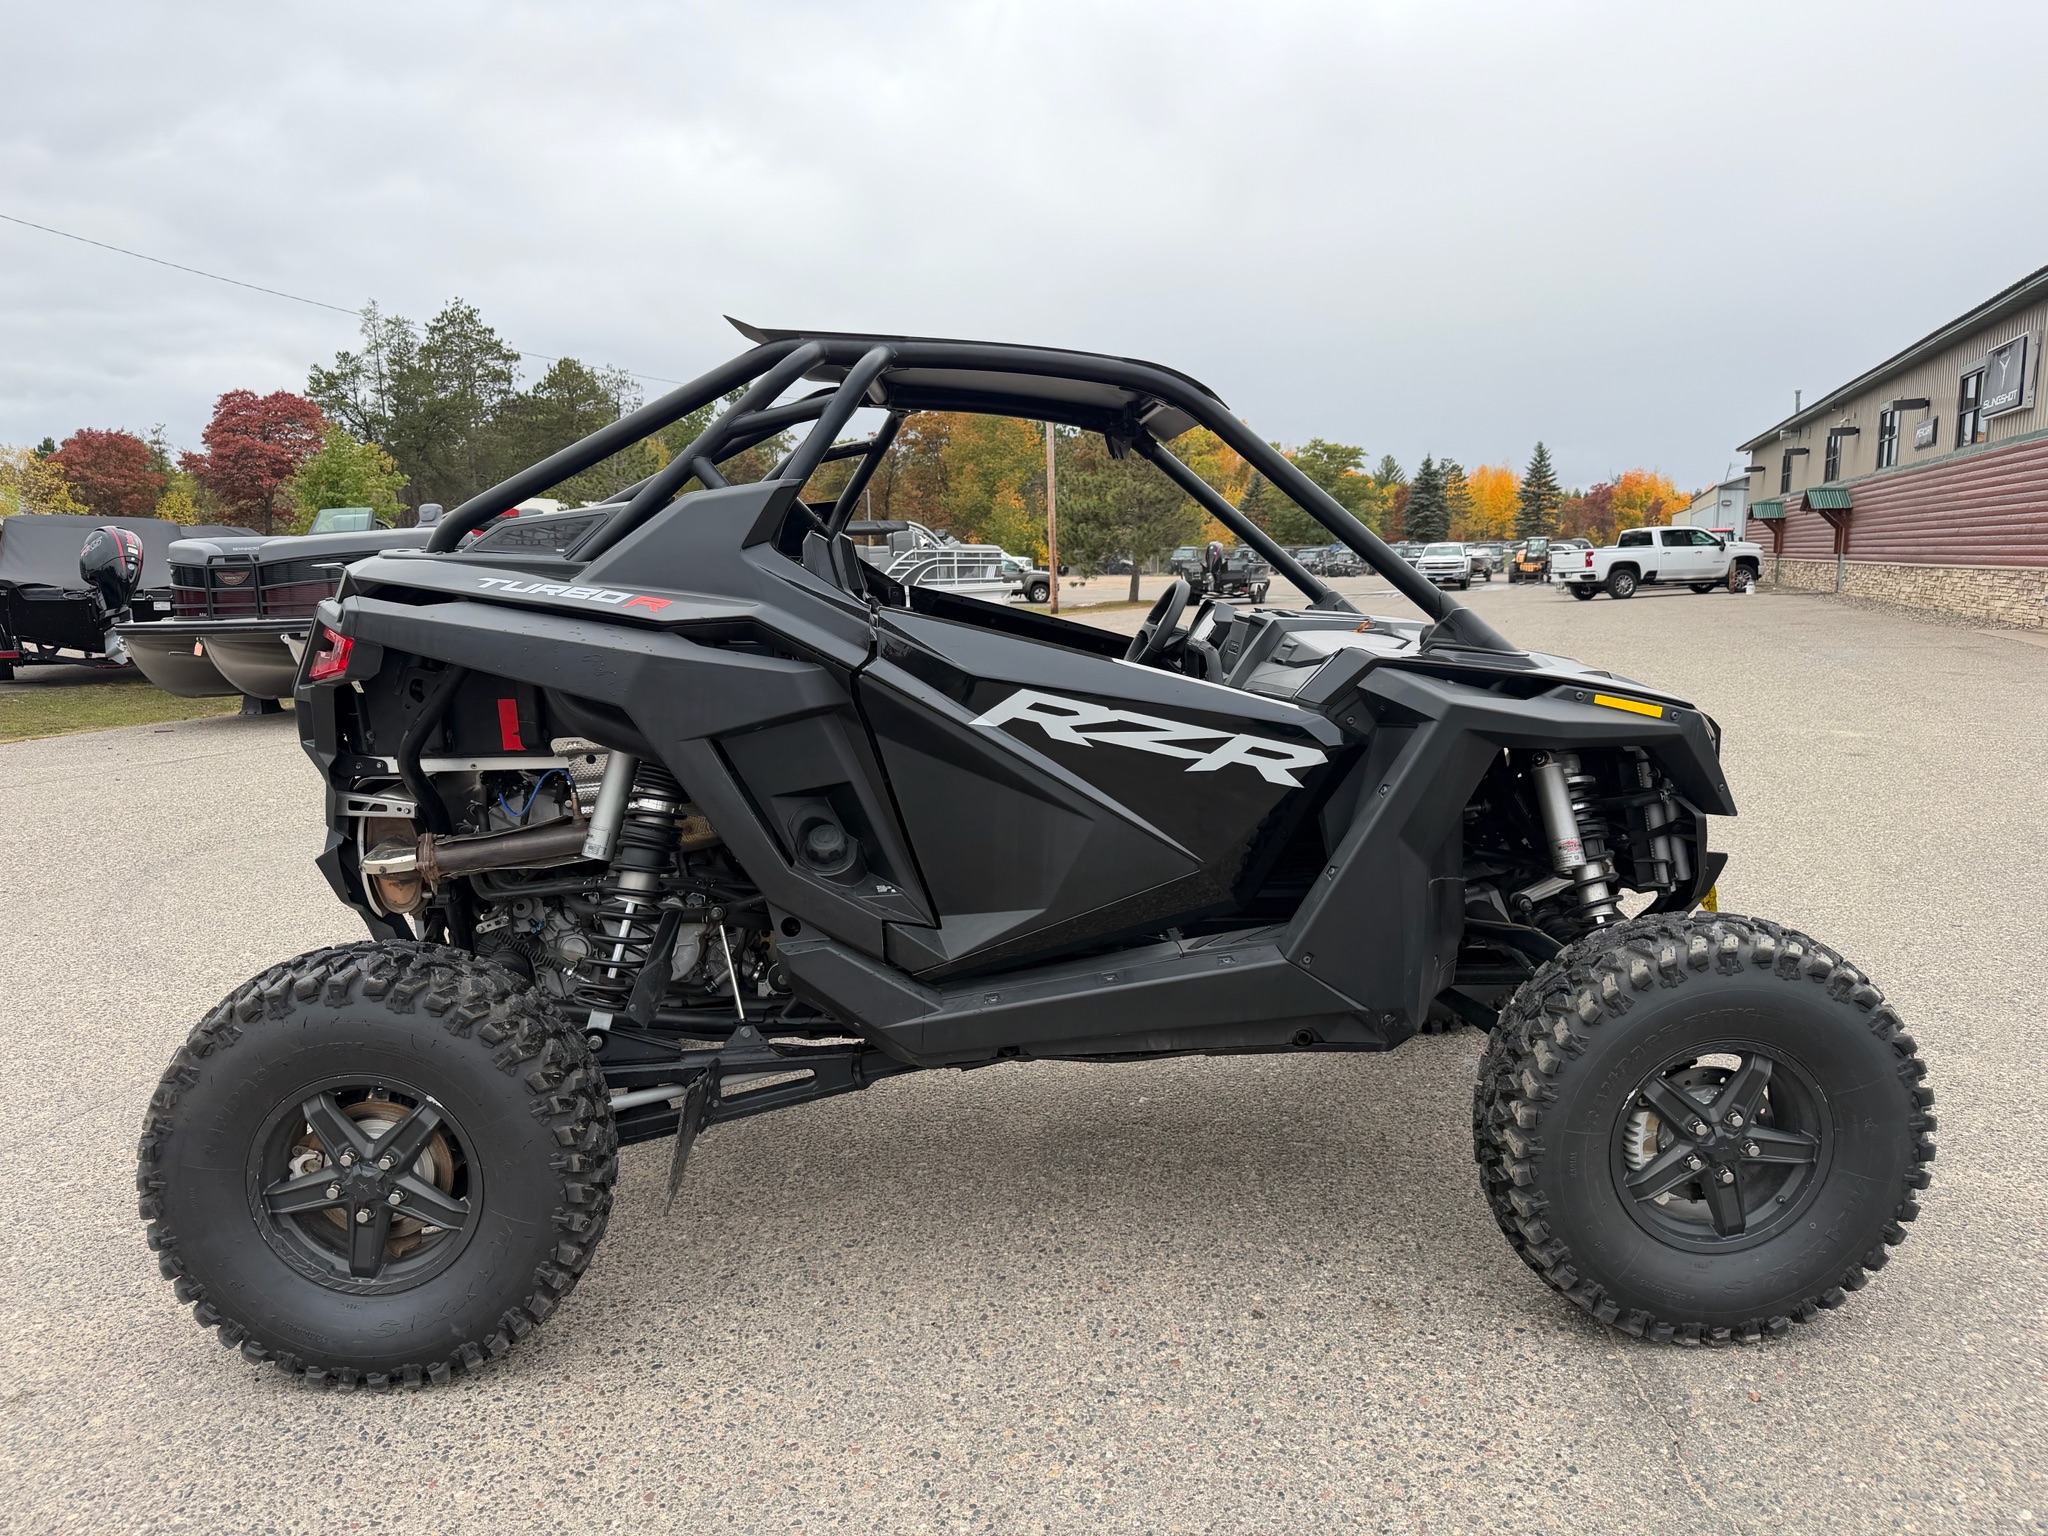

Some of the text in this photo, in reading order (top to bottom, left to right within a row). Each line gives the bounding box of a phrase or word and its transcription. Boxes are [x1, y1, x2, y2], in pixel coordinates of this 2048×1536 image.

[1983, 389, 2018, 410] SLINGSHOT
[478, 577, 634, 604] TURBO
[968, 689, 1329, 788] RZR
